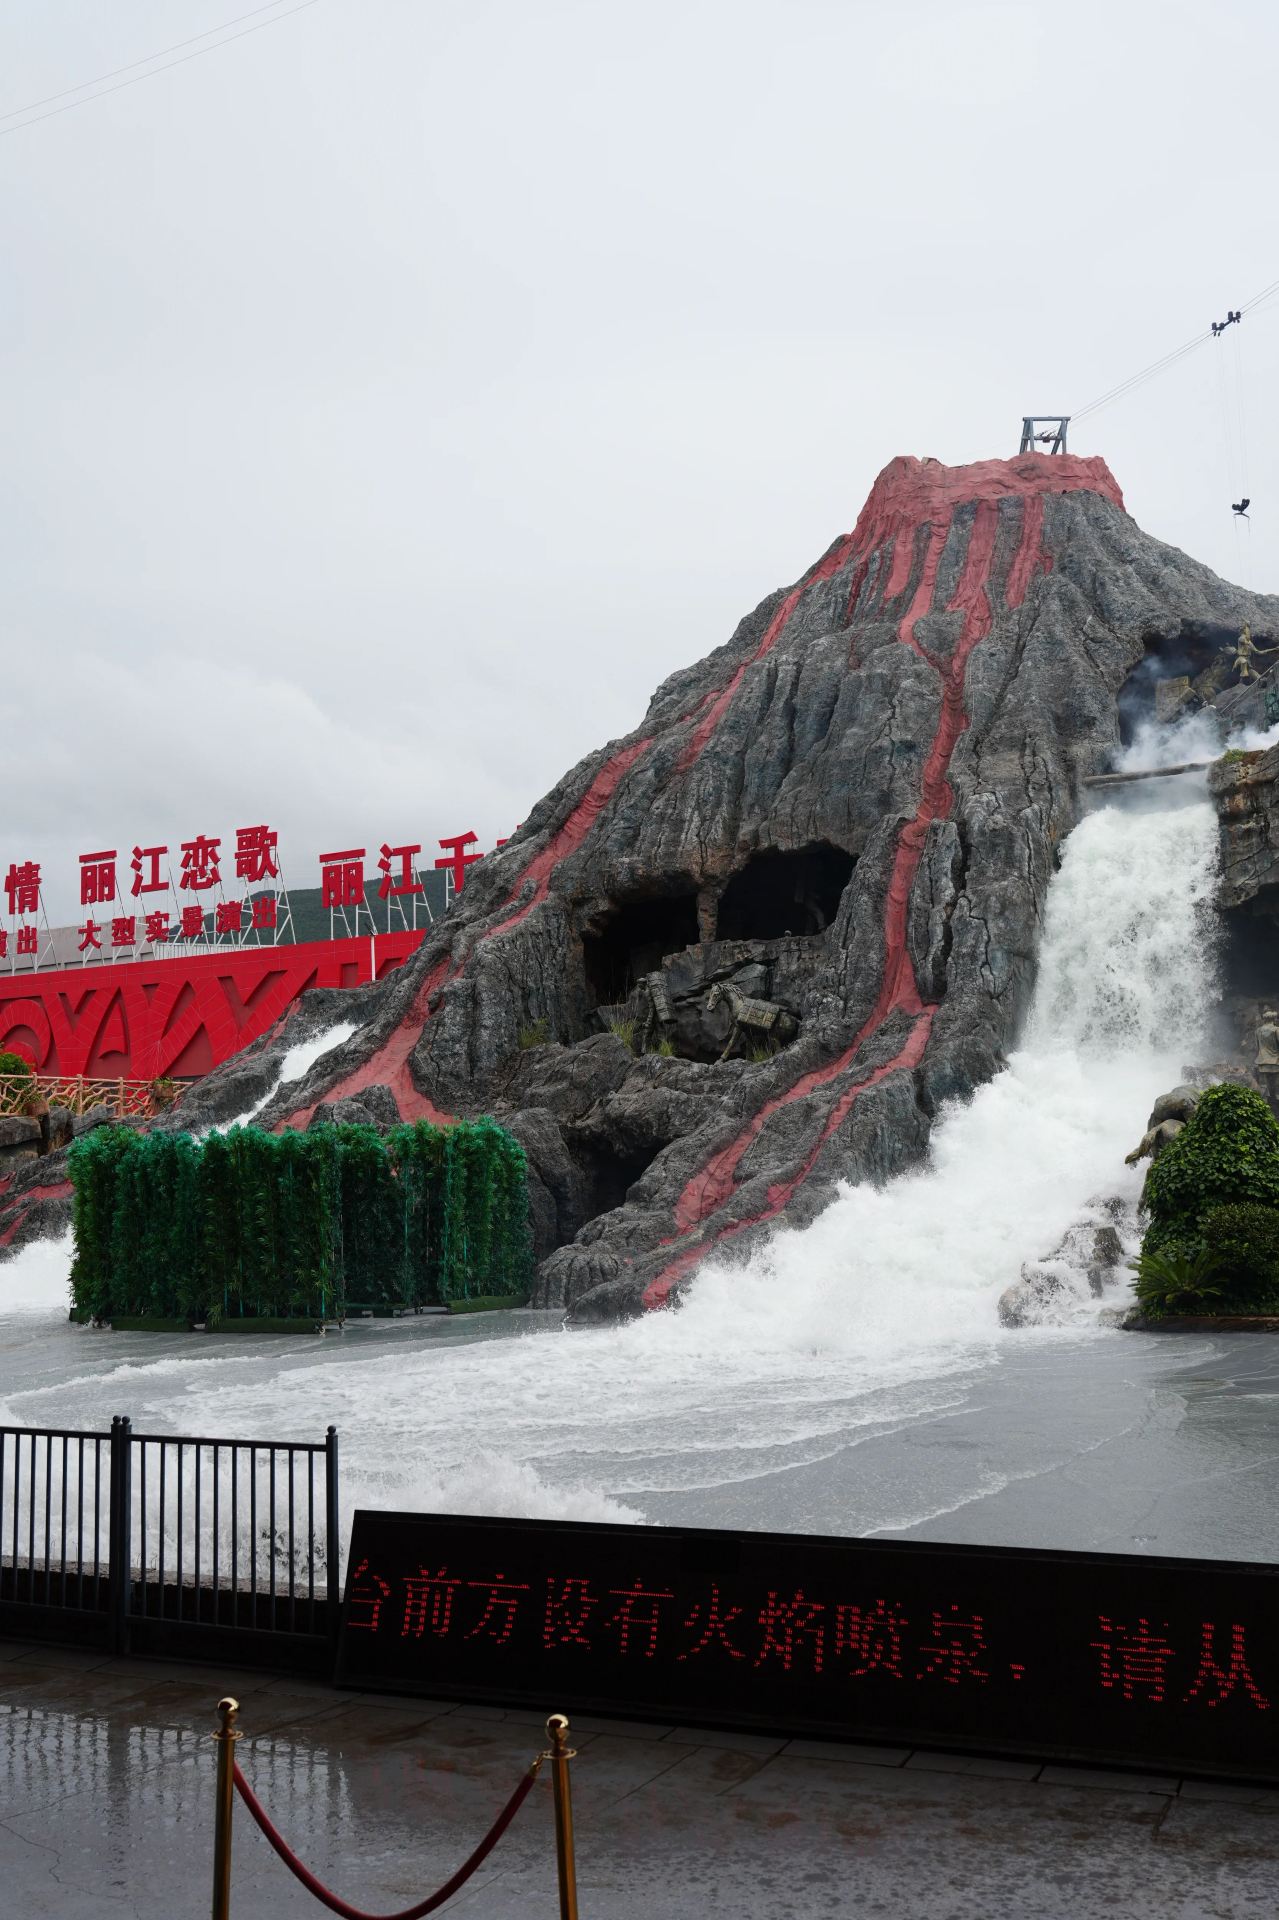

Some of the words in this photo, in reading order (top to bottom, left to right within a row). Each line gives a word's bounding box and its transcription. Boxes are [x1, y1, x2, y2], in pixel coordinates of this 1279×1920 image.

[4, 861, 42, 915] 情
[79, 825, 279, 905] 丽江恋歌
[319, 824, 521, 909] 丽江千
[78, 896, 277, 952] 大型实景演出
